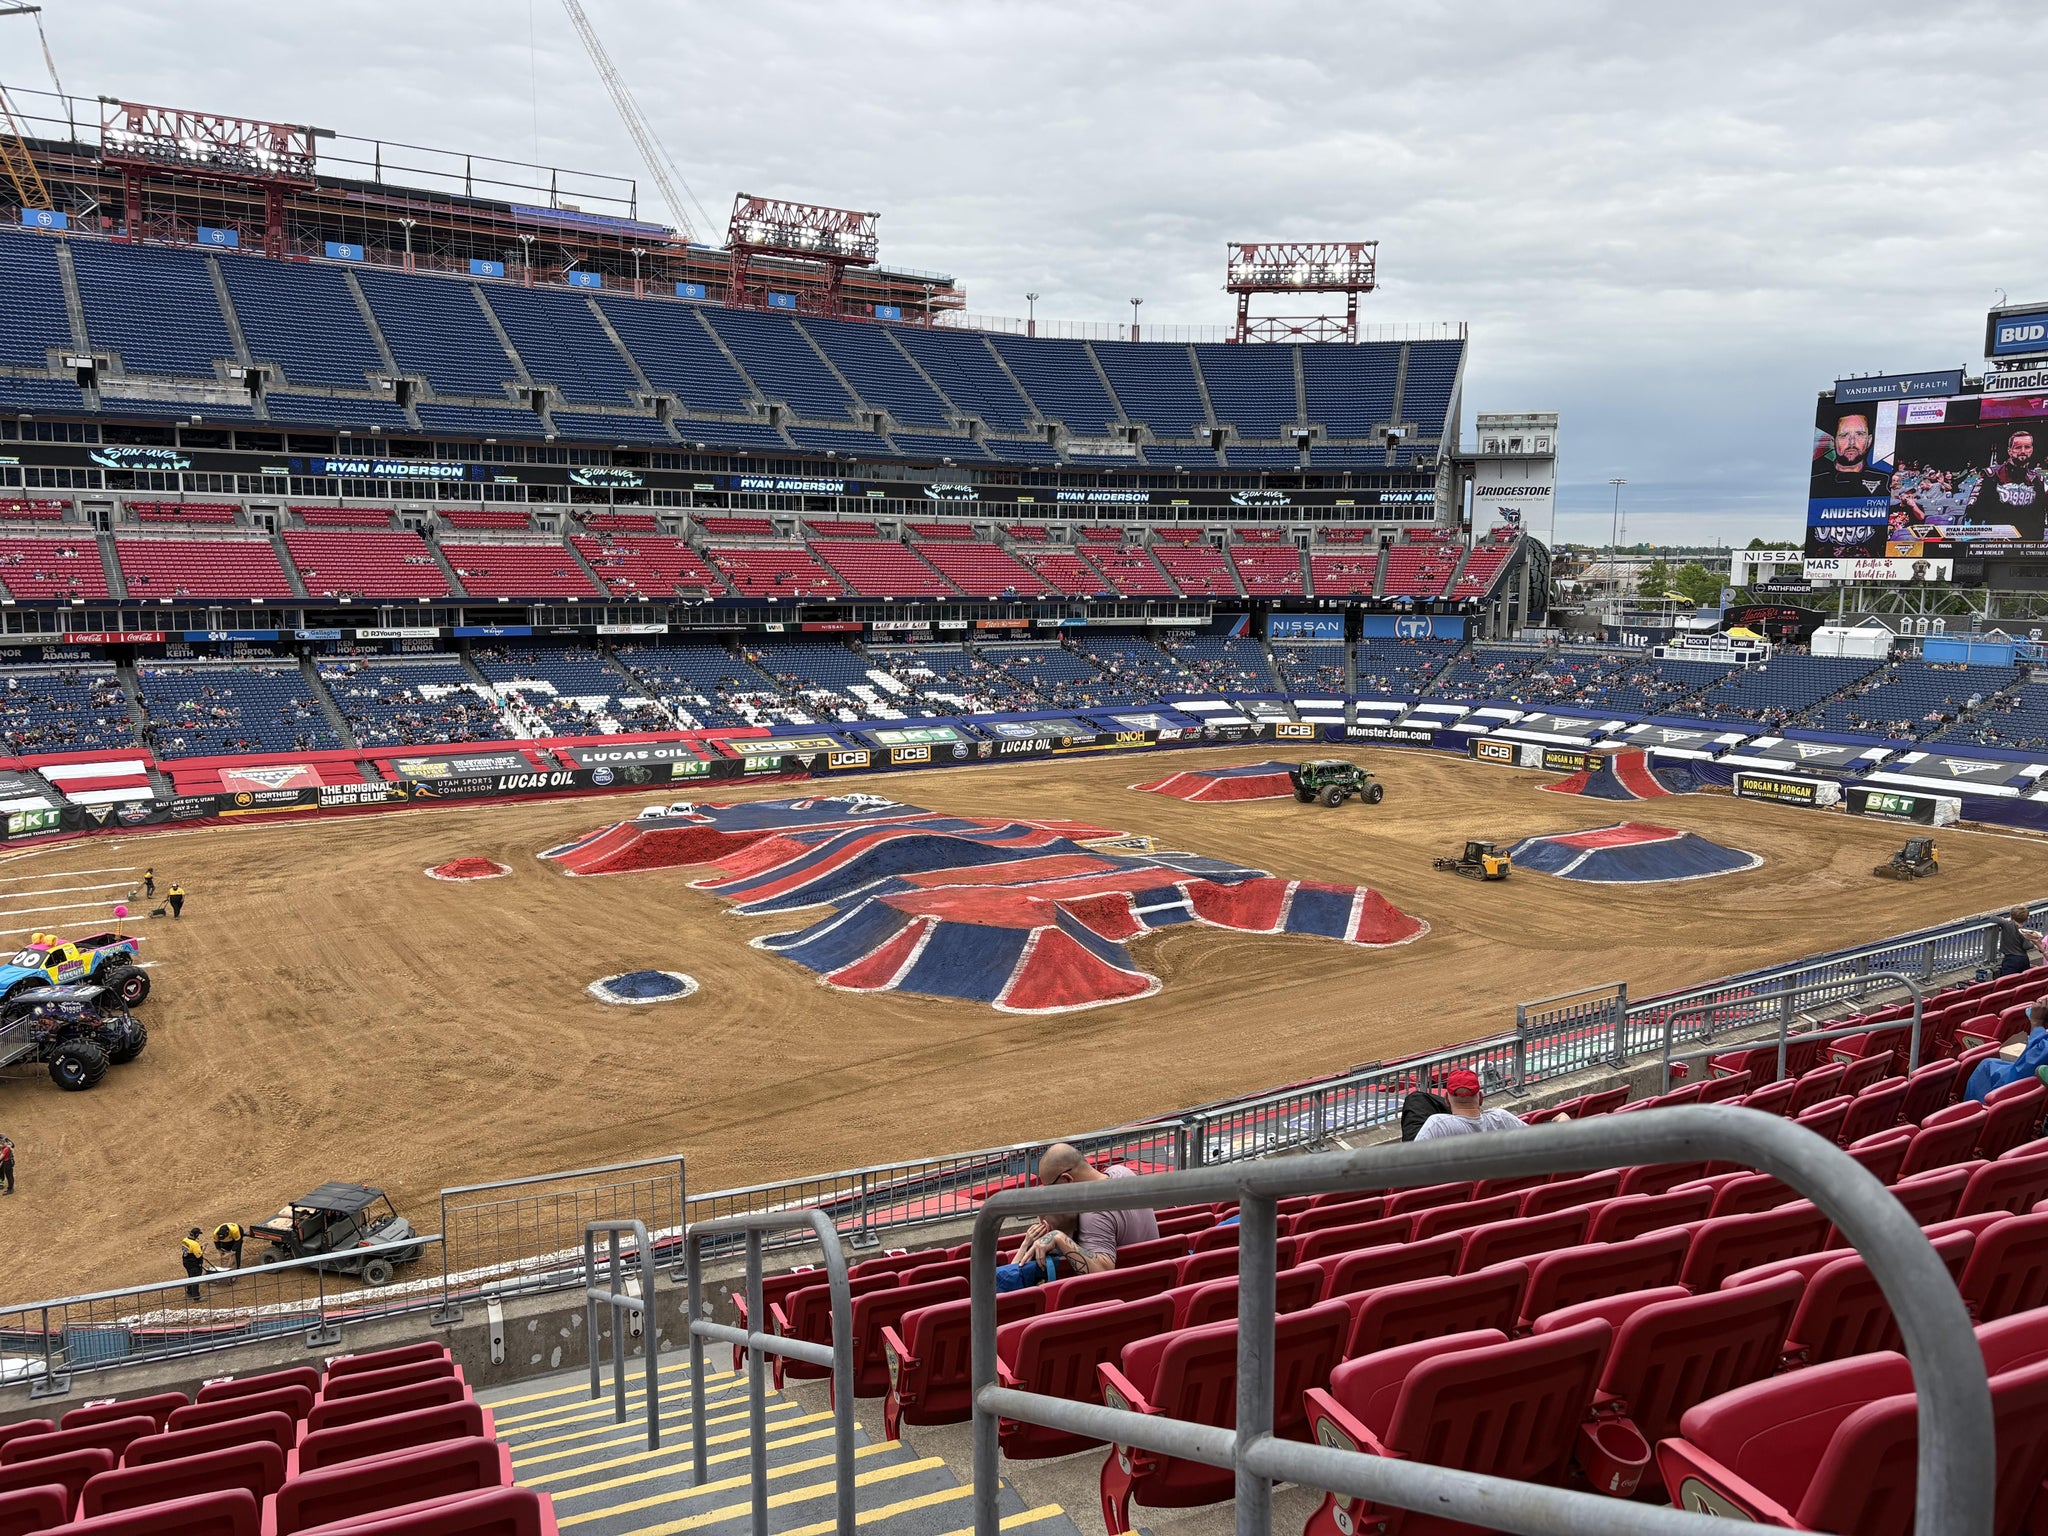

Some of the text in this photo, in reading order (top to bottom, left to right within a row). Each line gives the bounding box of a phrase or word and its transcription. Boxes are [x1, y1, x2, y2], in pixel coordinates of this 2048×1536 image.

[2001, 325, 2044, 342] BUD
[1986, 371, 2048, 390] Pinnacle
[1846, 380, 1948, 395] VANDERBILT HEALTH
[325, 462, 464, 476] RYAN ANDERSON
[741, 479, 844, 492] RYAN ANDERSON
[1476, 486, 1552, 496] BRIDGESTONE
[1056, 492, 1150, 502] RYAN ANDERSON
[1380, 493, 1411, 502] RYAN
[1866, 499, 1887, 507] RYAN
[1821, 507, 1887, 519] ANDERSON
[1806, 560, 1839, 569] MARS
[1273, 622, 1339, 630] NISSAN
[76, 633, 102, 642] Coca-Cola
[127, 633, 153, 642] Coca-Cola
[42, 645, 56, 653] KS
[166, 649, 194, 657] KEITH
[233, 648, 271, 656] NORTON
[42, 651, 91, 660] ADAMS JR
[880, 729, 949, 742] BKT
[1115, 731, 1145, 742] UNOH
[1279, 726, 1312, 735] JCB
[1347, 726, 1431, 742] MonsterJam.com
[1001, 740, 1035, 753] LUCAS
[1480, 744, 1510, 759] JCB
[582, 750, 649, 762] LUCAS
[832, 753, 867, 765] JCB
[894, 748, 928, 760] JCB
[1546, 753, 1568, 763] MORGAN
[1569, 756, 1573, 764] &
[672, 761, 711, 773] BKT
[745, 756, 781, 769] BKT
[228, 768, 308, 779] MONSTER
[463, 777, 492, 785] SPORTS
[499, 773, 547, 790] LUCAS
[320, 782, 391, 794] THE ORIGINAL
[438, 784, 493, 795] COMMISSION
[1743, 779, 1812, 796] MORGAN & MORGAN
[255, 790, 300, 799] NORTHERN
[321, 792, 388, 804] SUPER GLUE
[1866, 794, 1913, 812] BKT
[9, 811, 60, 832] BKT
[33, 828, 60, 836] TOGETHER
[1338, 1512, 1347, 1528] G
